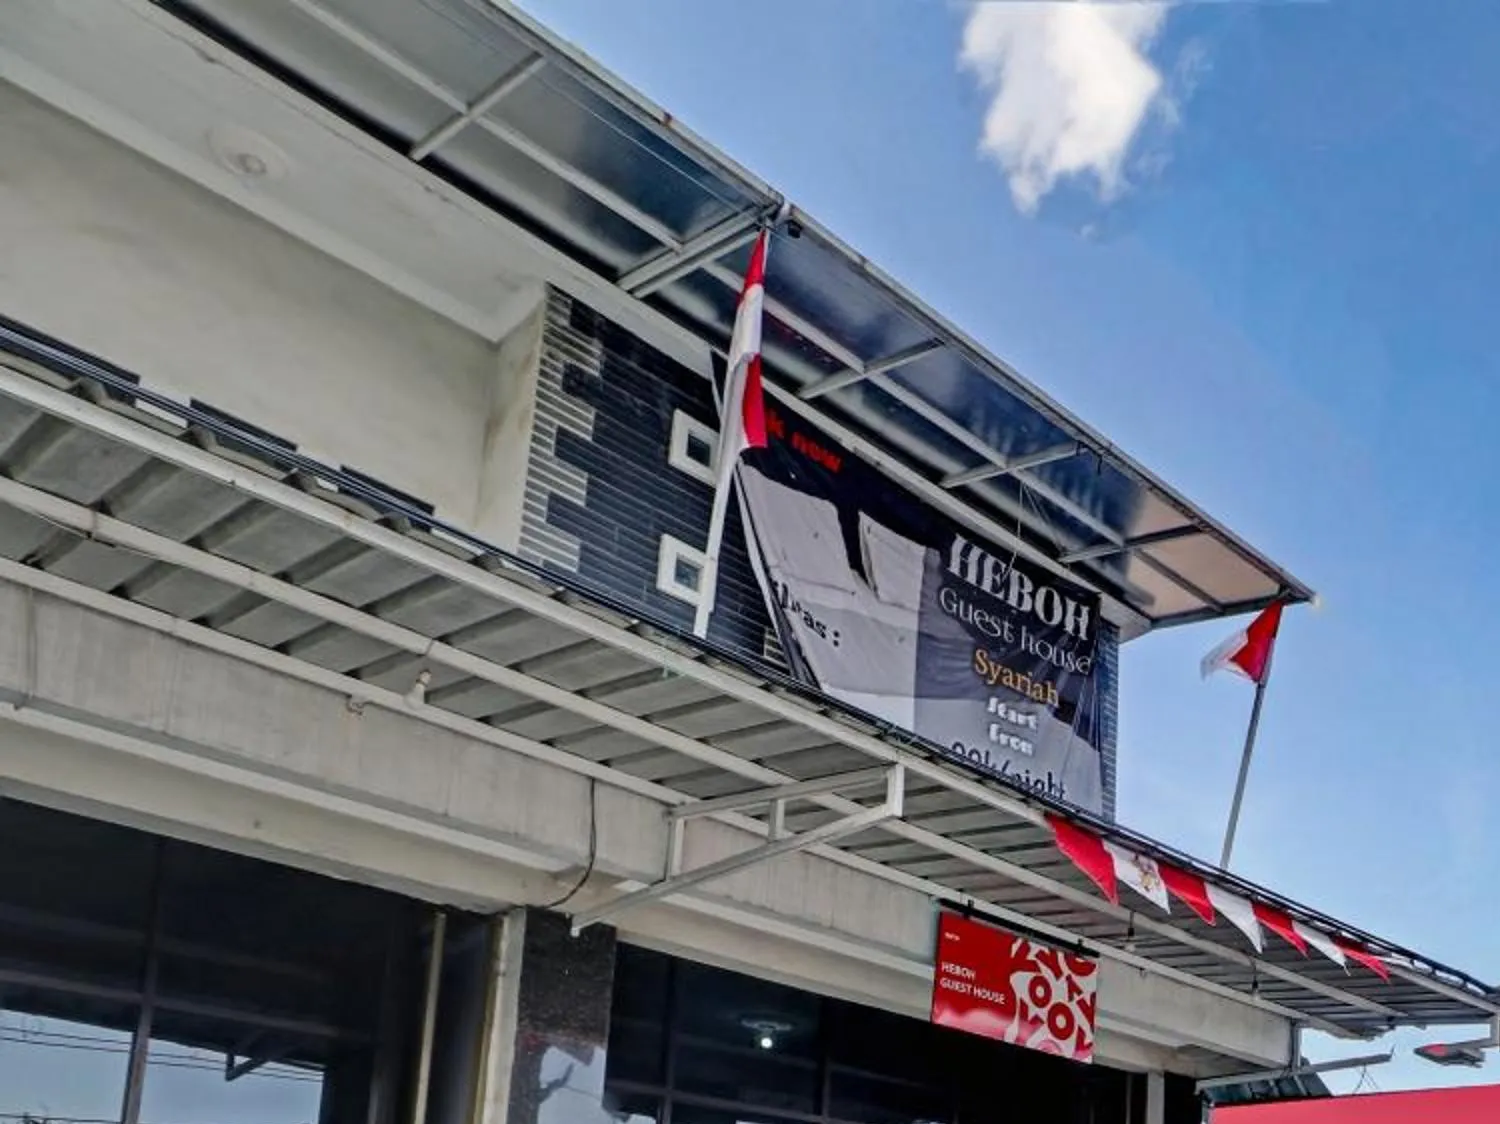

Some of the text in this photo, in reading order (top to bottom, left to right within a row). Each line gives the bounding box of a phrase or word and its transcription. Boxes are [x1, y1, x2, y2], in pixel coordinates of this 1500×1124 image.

[947, 533, 1091, 641] HEBOH
[939, 587, 1092, 676] Guest house
[974, 648, 1060, 708] Syariah
[940, 977, 1006, 1006] GUEST HOUSE
[941, 961, 976, 981] HEBOH
